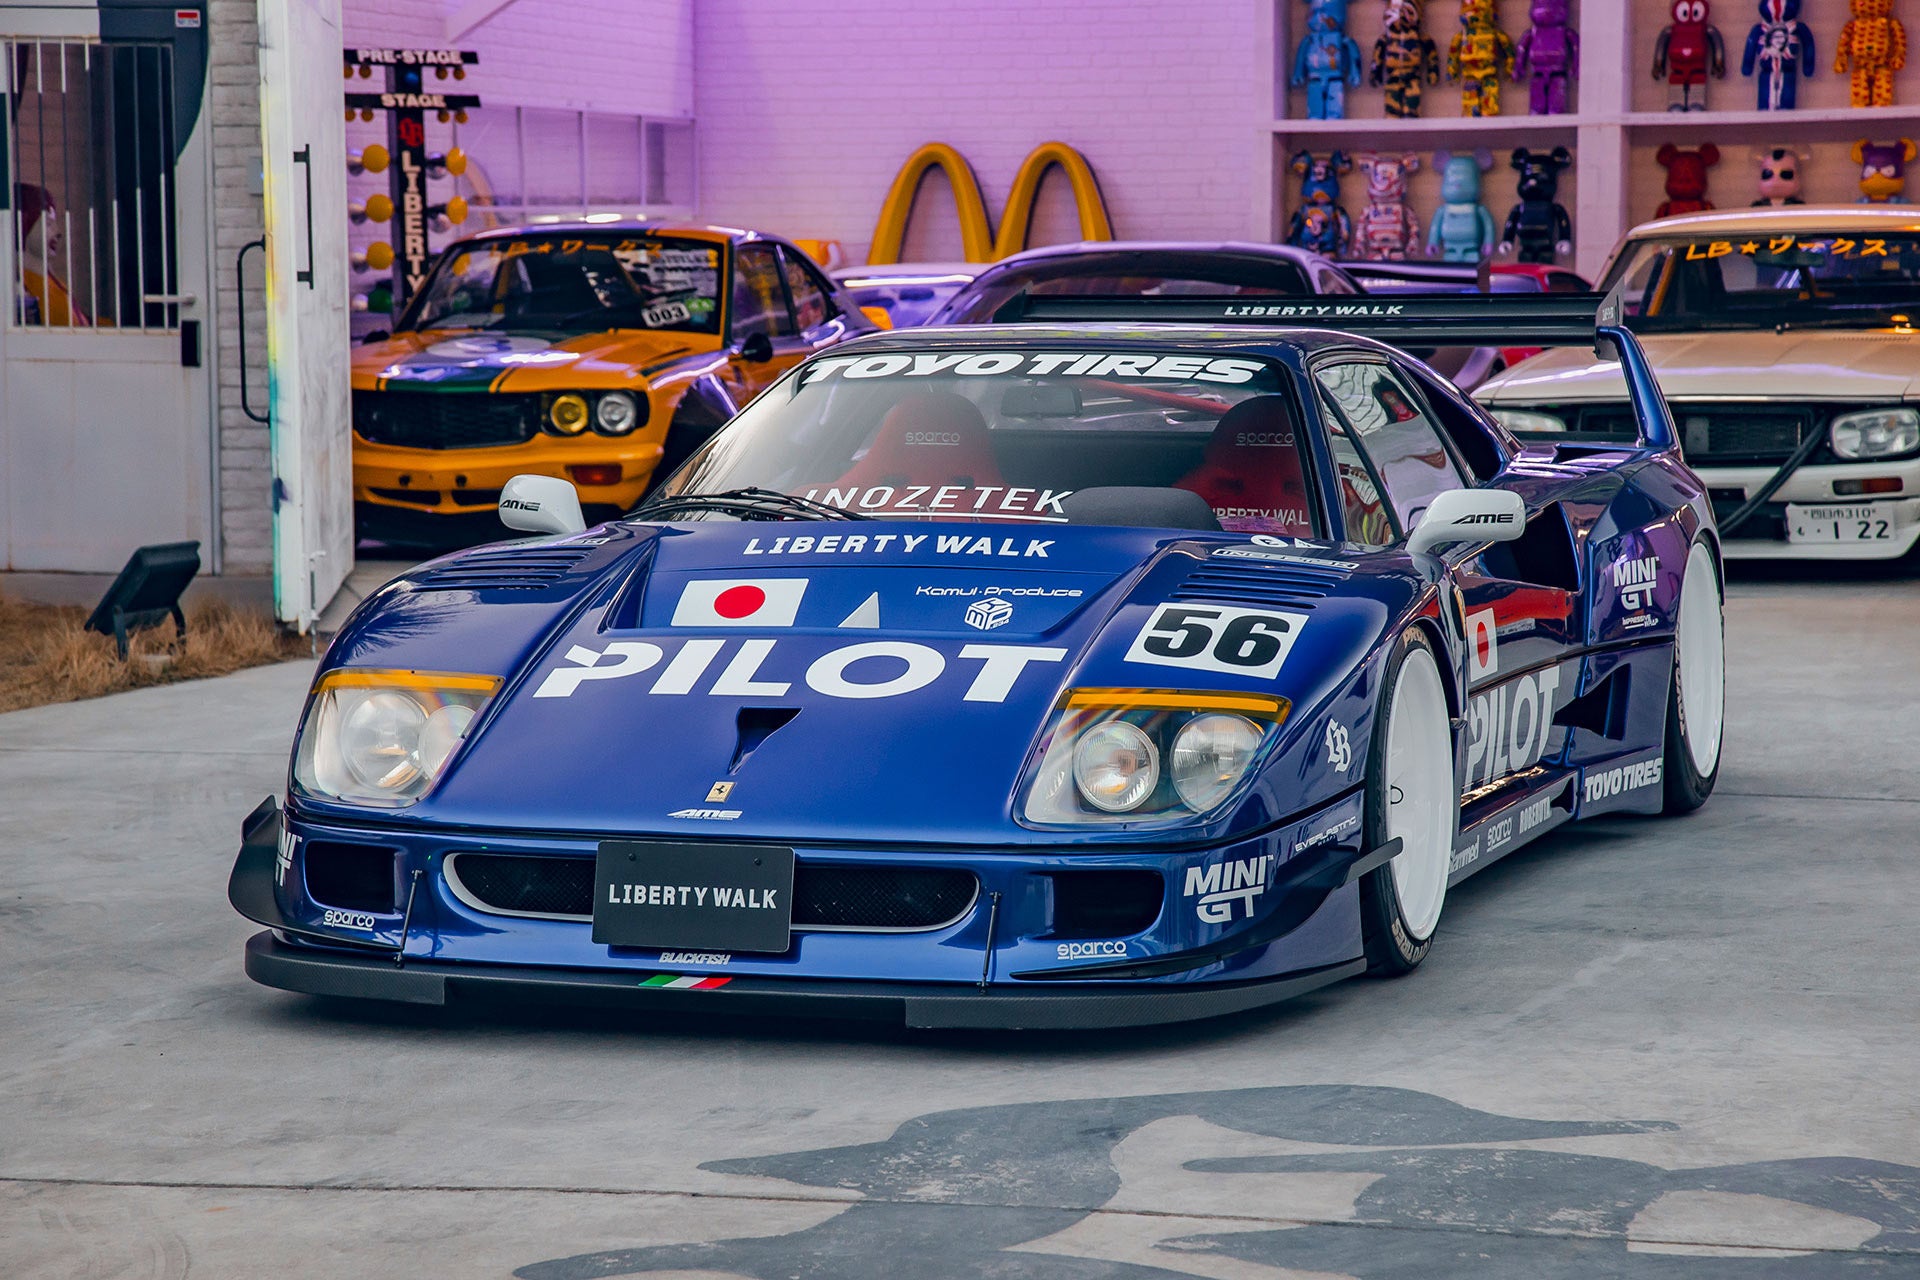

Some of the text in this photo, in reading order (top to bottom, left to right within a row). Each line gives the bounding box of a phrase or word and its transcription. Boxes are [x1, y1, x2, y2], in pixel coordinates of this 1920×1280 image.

[357, 50, 464, 64] PRE-STAGE
[381, 93, 447, 108] STAGE
[402, 150, 426, 294] LIBERTY
[649, 306, 685, 324] 003
[1224, 305, 1403, 316] LIBERTY WALK
[801, 354, 1266, 384] TOYO TIRES
[905, 431, 960, 445] sparco
[1236, 433, 1295, 446] sparco
[801, 485, 1073, 514] INOZETEK
[1451, 513, 1514, 525] AME
[743, 534, 1056, 558] LIBERTY WALK
[1621, 581, 1657, 610] GT
[1144, 608, 1290, 666] 56
[532, 639, 1069, 703] PILOT
[1464, 665, 1560, 794] PILOT
[1584, 757, 1663, 803] TOYO TIRES
[1295, 816, 1357, 852] EVERLASTING
[1183, 855, 1267, 897] MINI
[609, 884, 777, 909] LIBERTY WALK
[1196, 885, 1264, 924] GT
[323, 910, 375, 931] sparco
[658, 952, 731, 965] BLACKFISH
[1056, 941, 1127, 960] sparco
